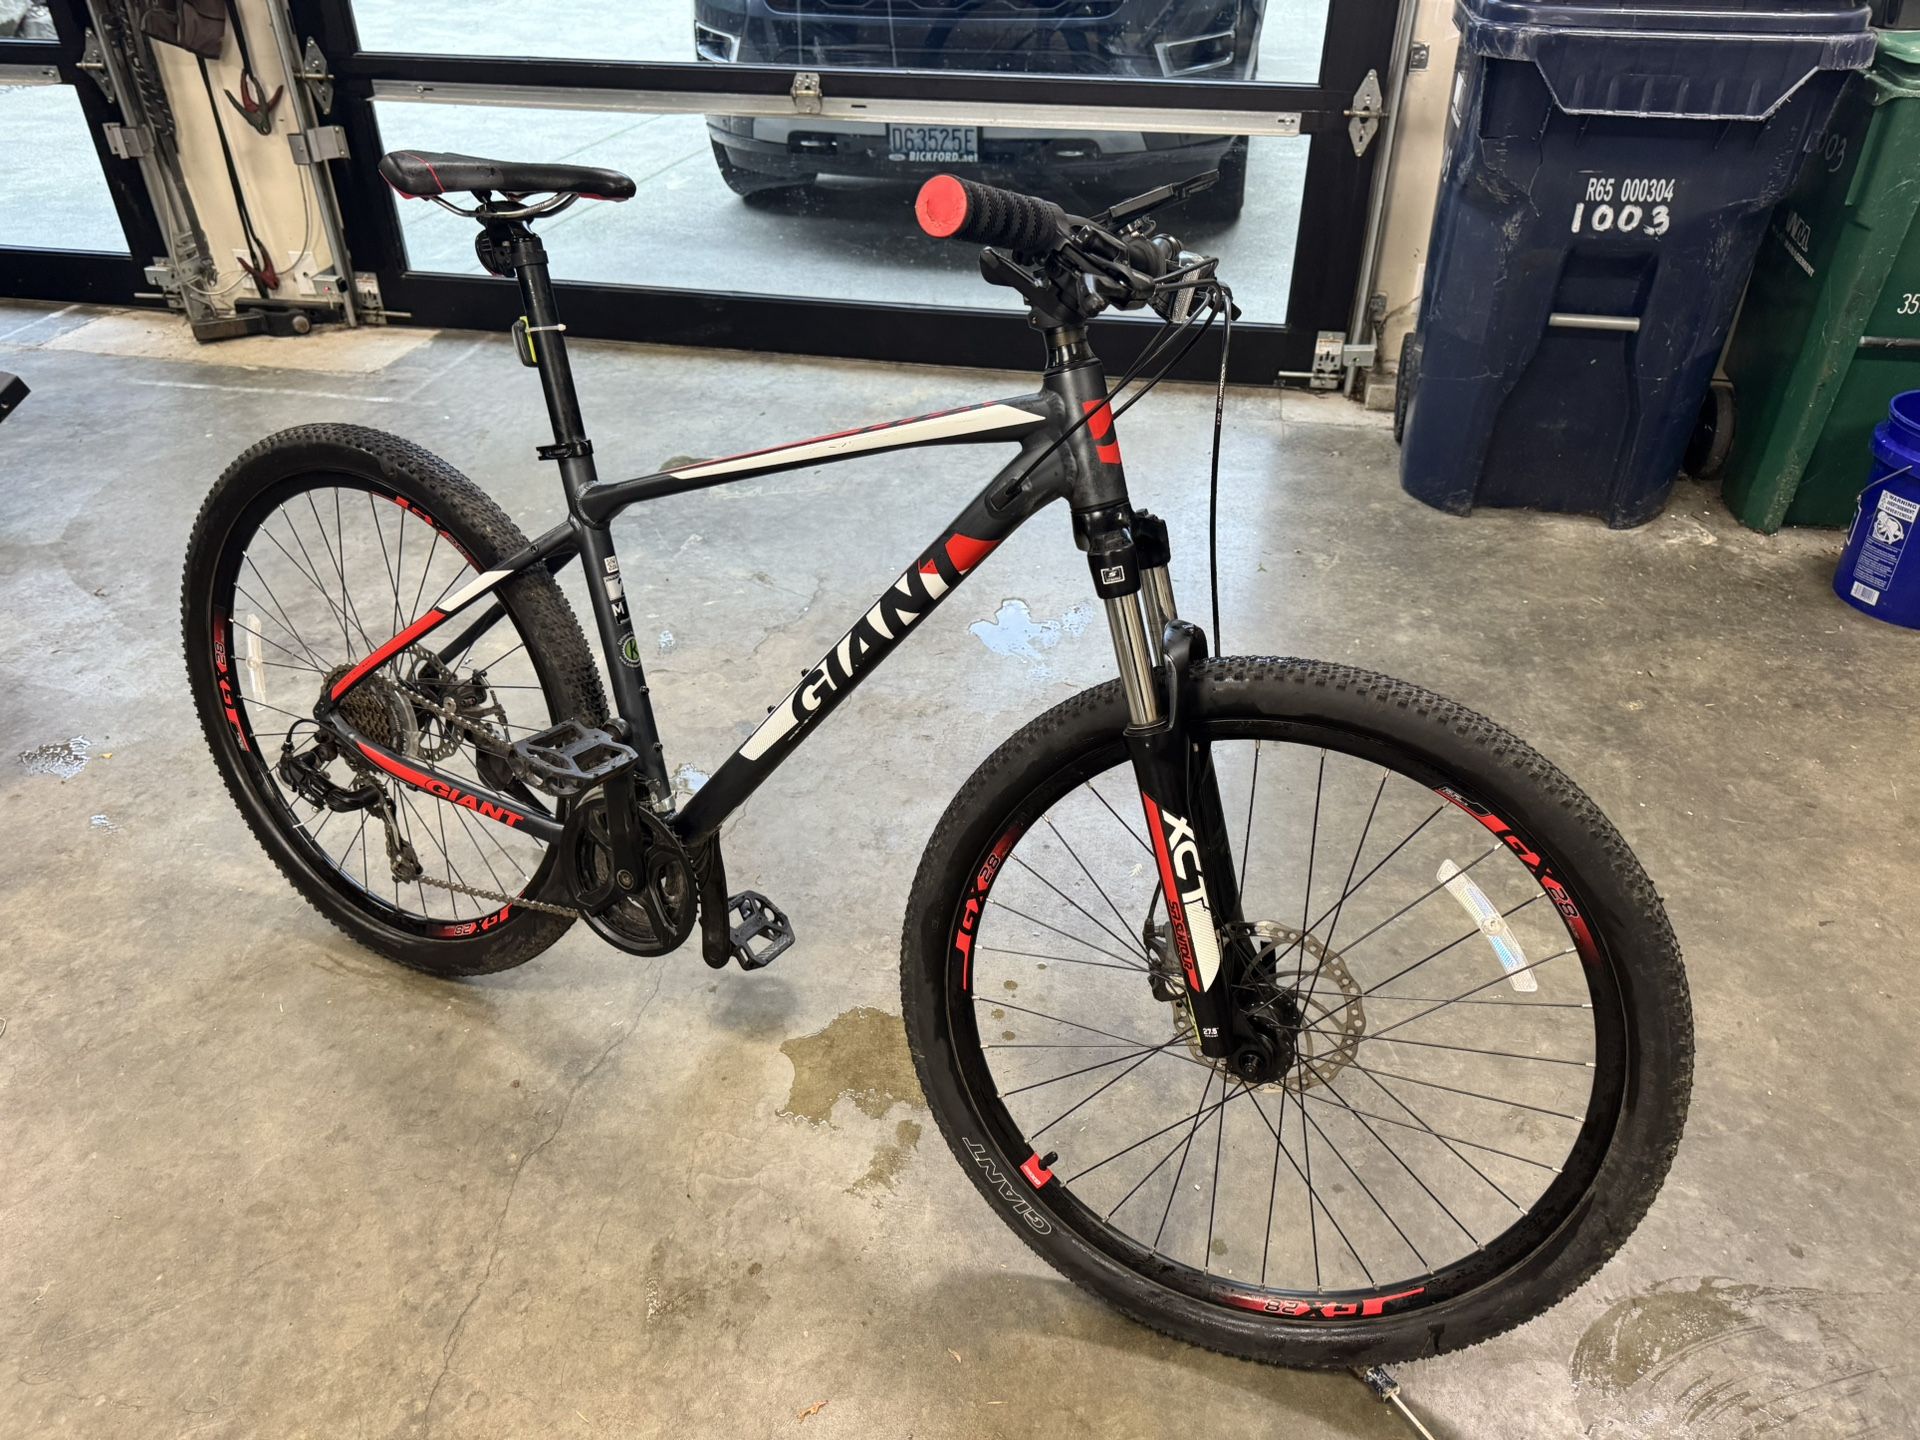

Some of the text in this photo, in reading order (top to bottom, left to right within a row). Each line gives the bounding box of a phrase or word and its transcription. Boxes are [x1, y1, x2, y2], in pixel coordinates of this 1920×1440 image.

[1585, 177, 1676, 202] R65 000304
[1571, 202, 1670, 236] 1003
[1896, 293, 1920, 315] 35
[791, 533, 964, 722] GIANT
[425, 780, 525, 827] GIANT
[1161, 809, 1211, 909] XCT
[961, 1136, 1052, 1235] GIANT
